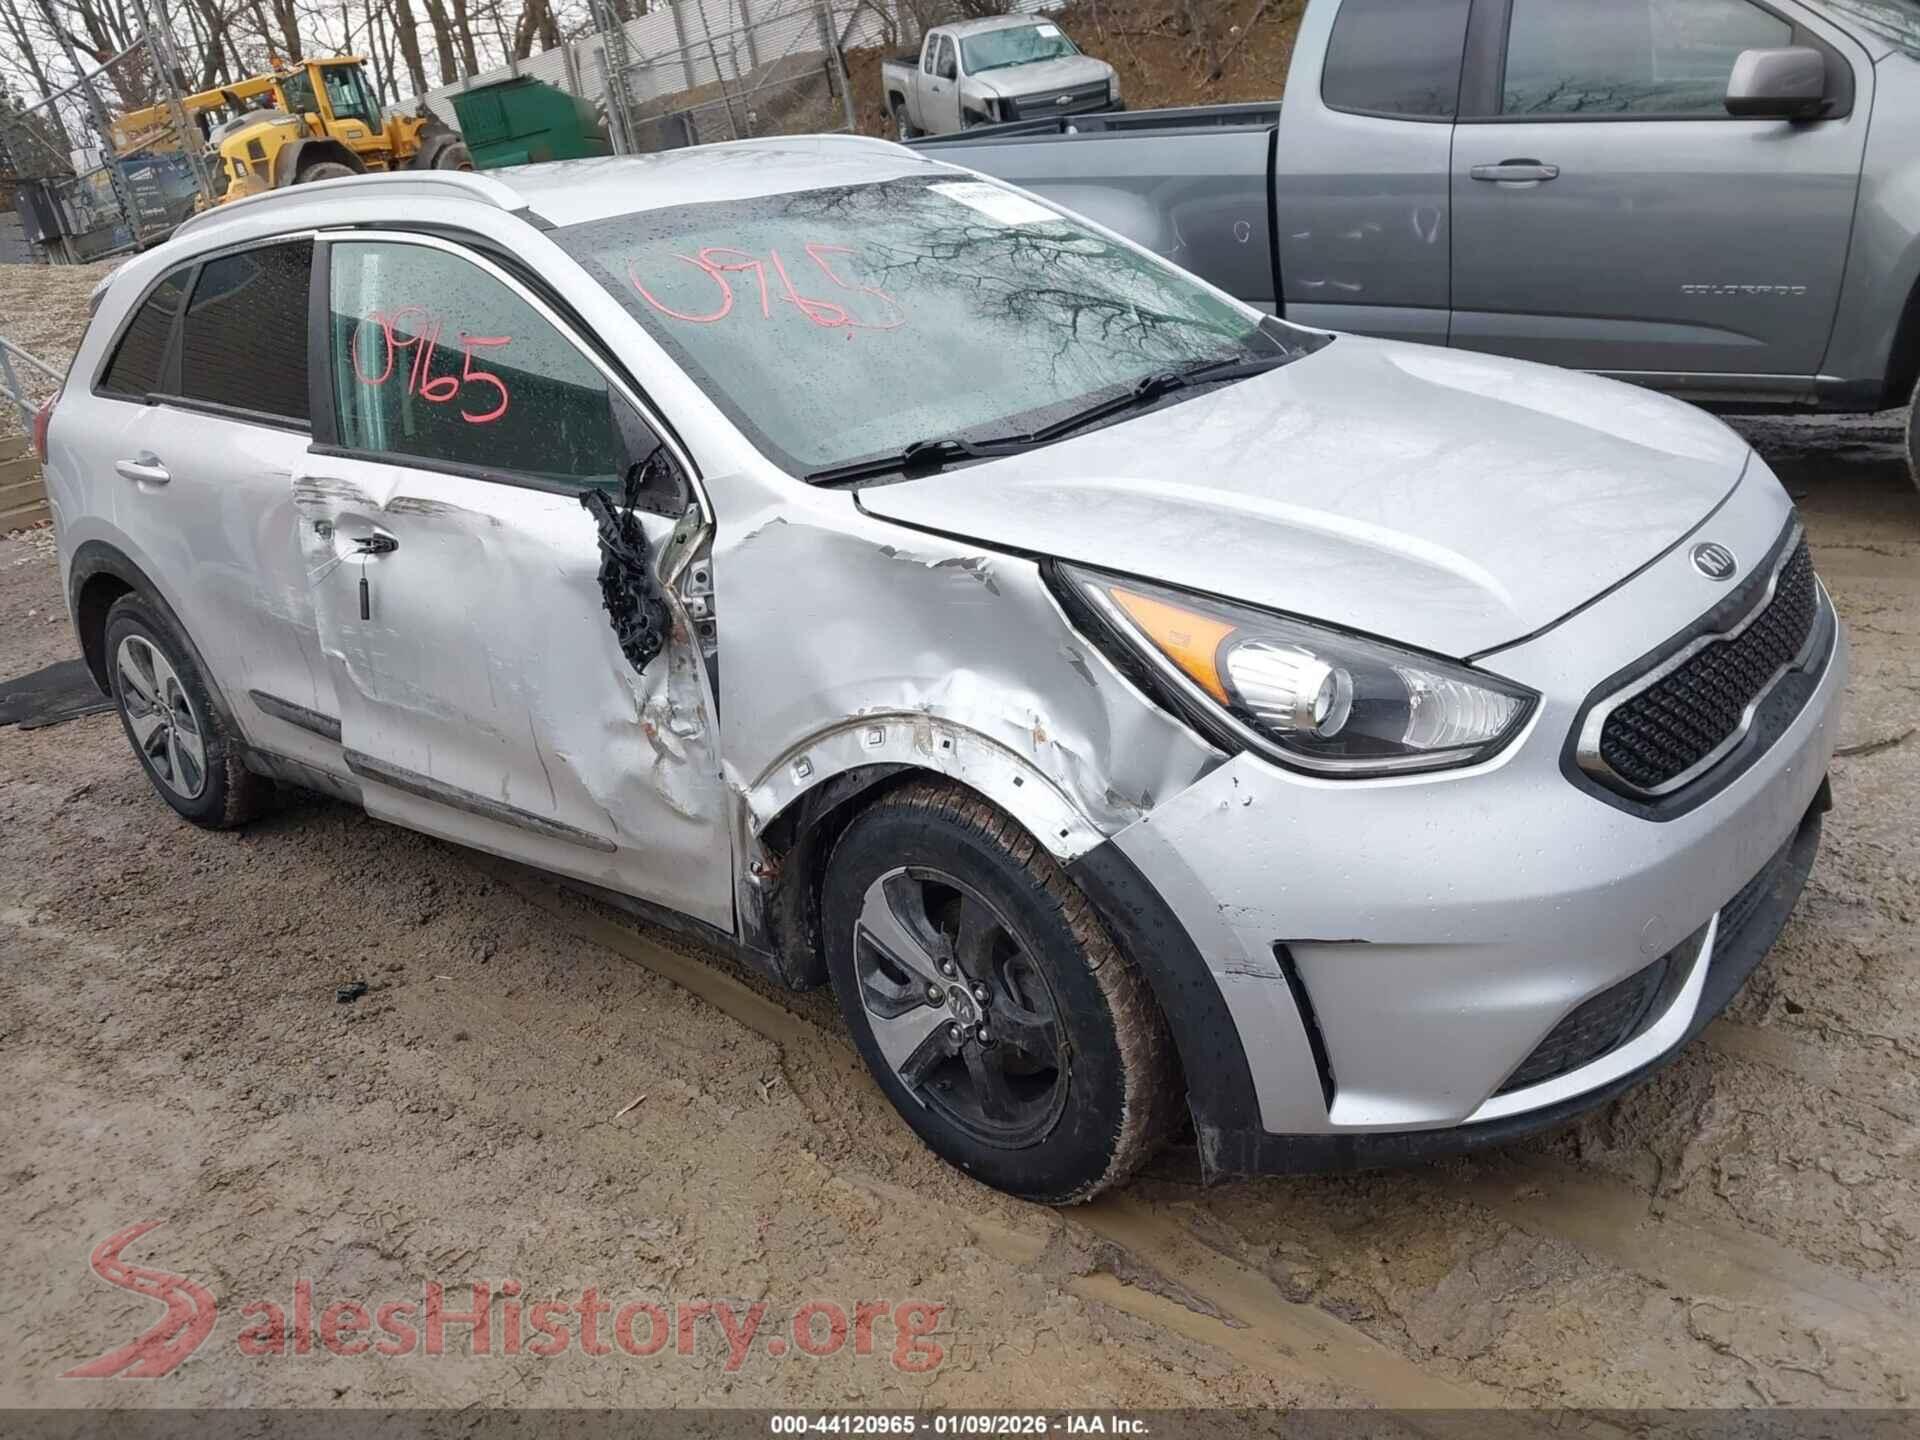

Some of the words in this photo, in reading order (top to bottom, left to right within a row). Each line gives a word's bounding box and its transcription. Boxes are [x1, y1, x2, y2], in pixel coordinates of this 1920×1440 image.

[627, 244, 906, 329] 0965
[1680, 284, 1808, 297] COLORADO
[352, 305, 512, 423] 0965
